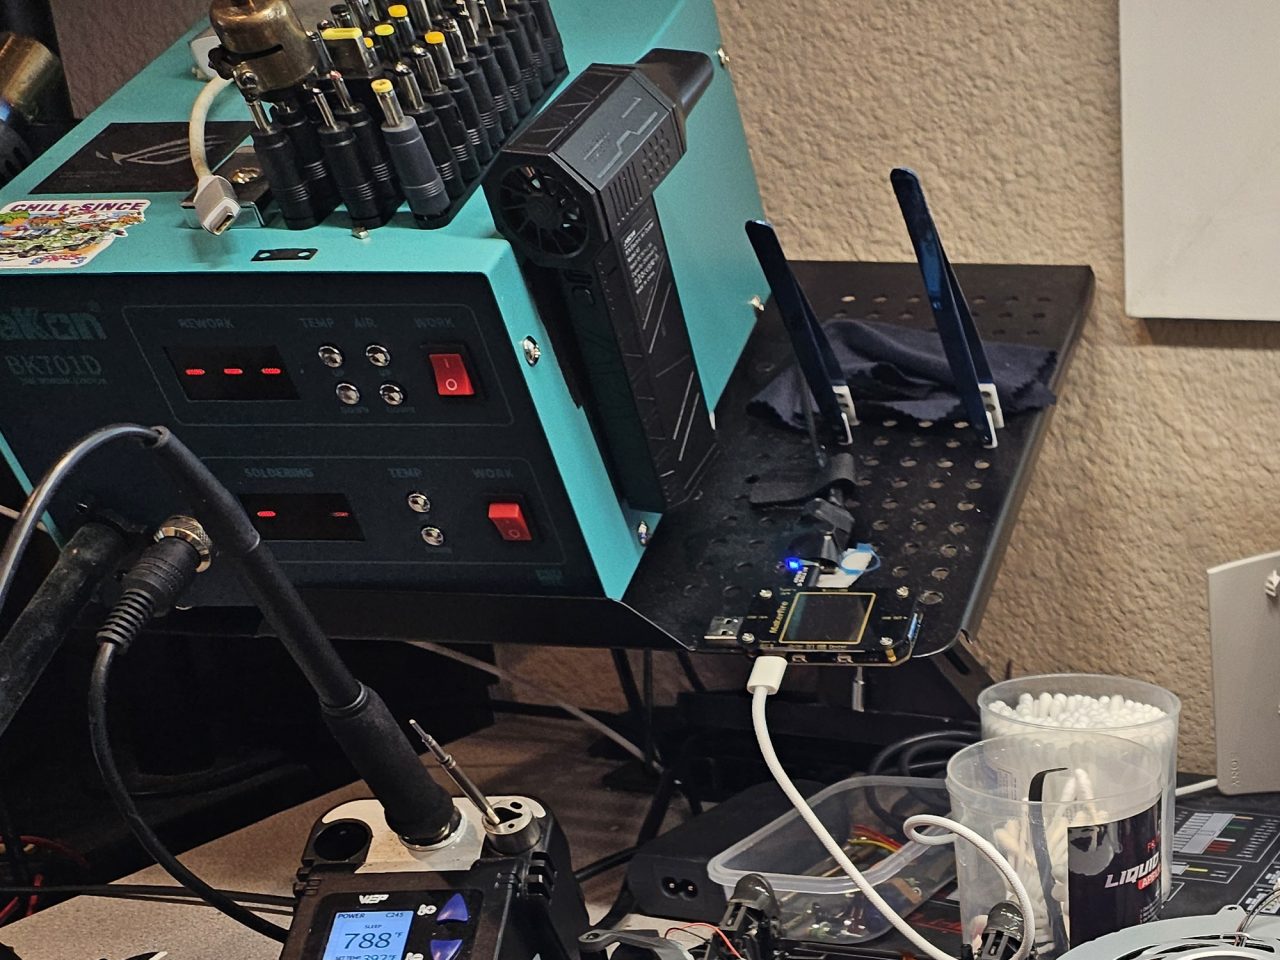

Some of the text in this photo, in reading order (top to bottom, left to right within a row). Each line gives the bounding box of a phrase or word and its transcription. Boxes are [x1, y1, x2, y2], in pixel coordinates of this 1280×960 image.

[9, 202, 146, 213] CHILL SINCE
[178, 318, 235, 329] REWORK
[300, 318, 335, 329] TEMP
[415, 318, 455, 329] WORK
[387, 468, 424, 479] TEMP
[471, 468, 513, 479] WORK
[343, 932, 392, 949] 788
